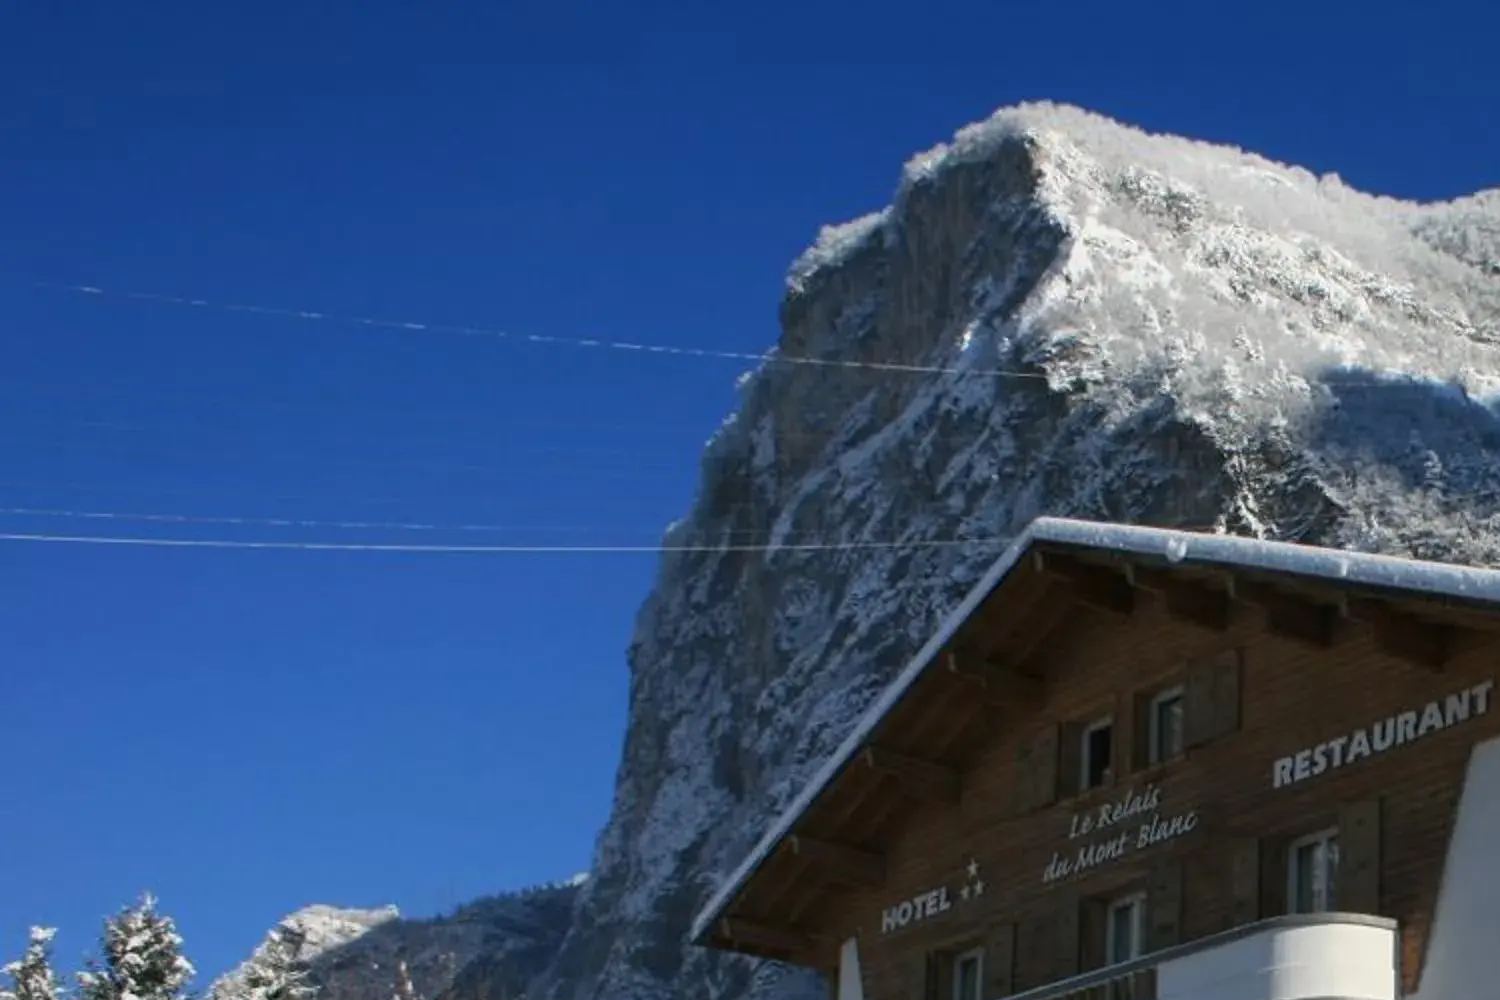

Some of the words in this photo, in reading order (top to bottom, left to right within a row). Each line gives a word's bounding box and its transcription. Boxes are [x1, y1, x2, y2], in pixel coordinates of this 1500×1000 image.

[1273, 679, 1494, 788] RESTAURANT
[1042, 852, 1071, 883] du
[1073, 830, 1127, 874] Mont
[1136, 811, 1199, 849] Blanc
[1068, 815, 1095, 840] Le
[882, 886, 951, 935] HOTEL
